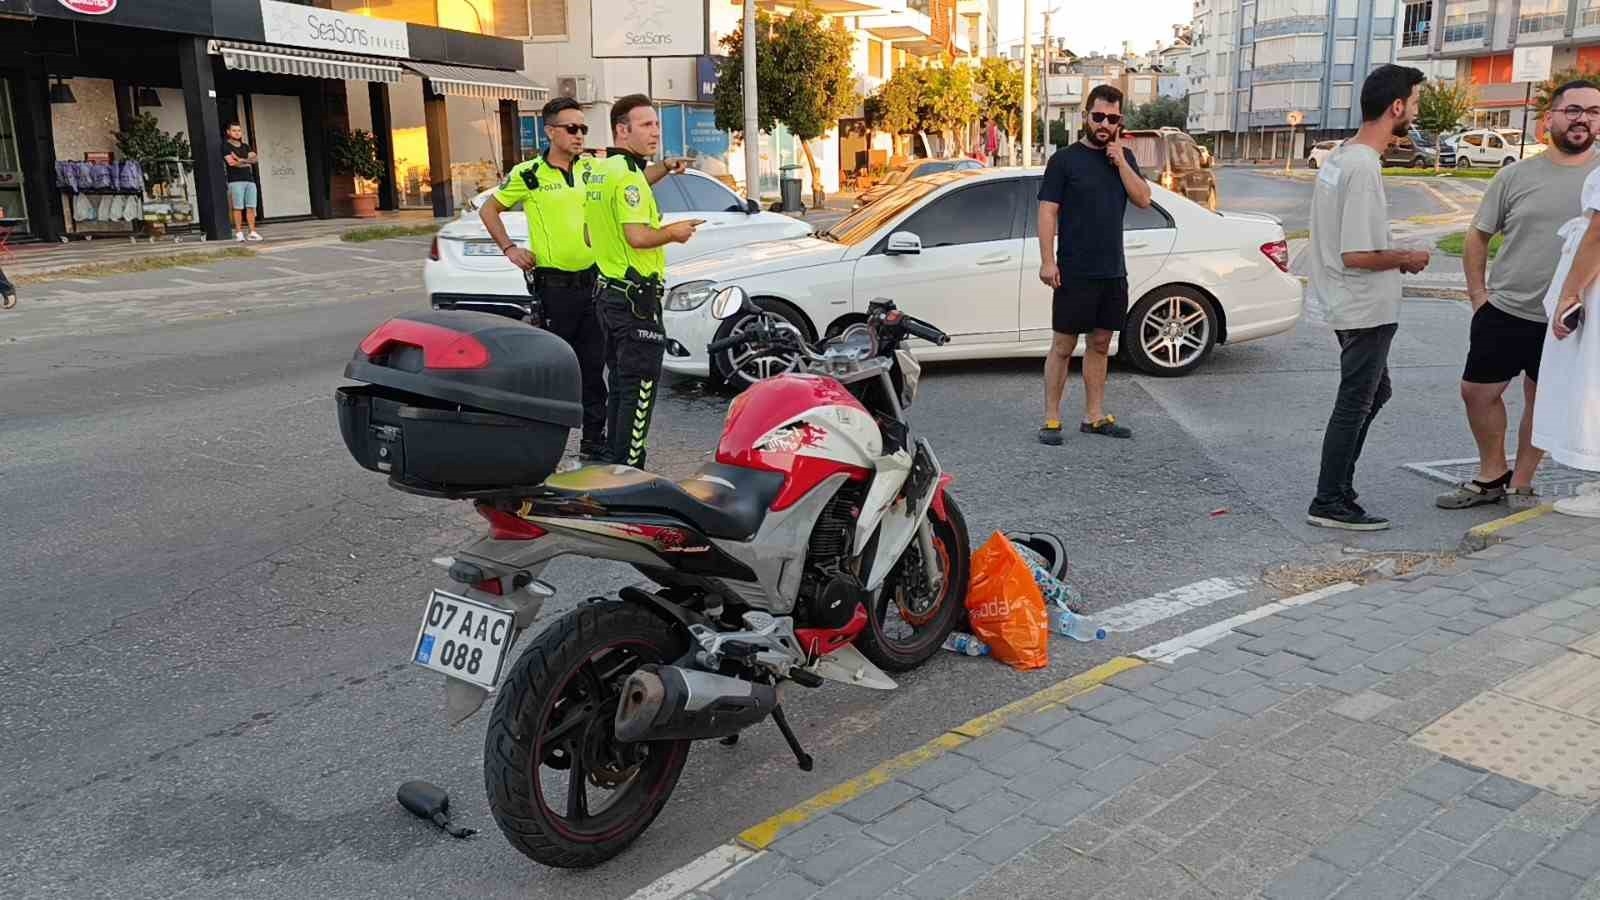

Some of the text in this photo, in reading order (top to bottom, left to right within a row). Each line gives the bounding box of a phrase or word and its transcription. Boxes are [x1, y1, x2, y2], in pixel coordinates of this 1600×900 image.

[307, 14, 407, 50] SeaSons TRAVEL
[624, 31, 673, 46] SeaSons
[429, 601, 506, 646] 07 AAC
[440, 639, 483, 675] 088
